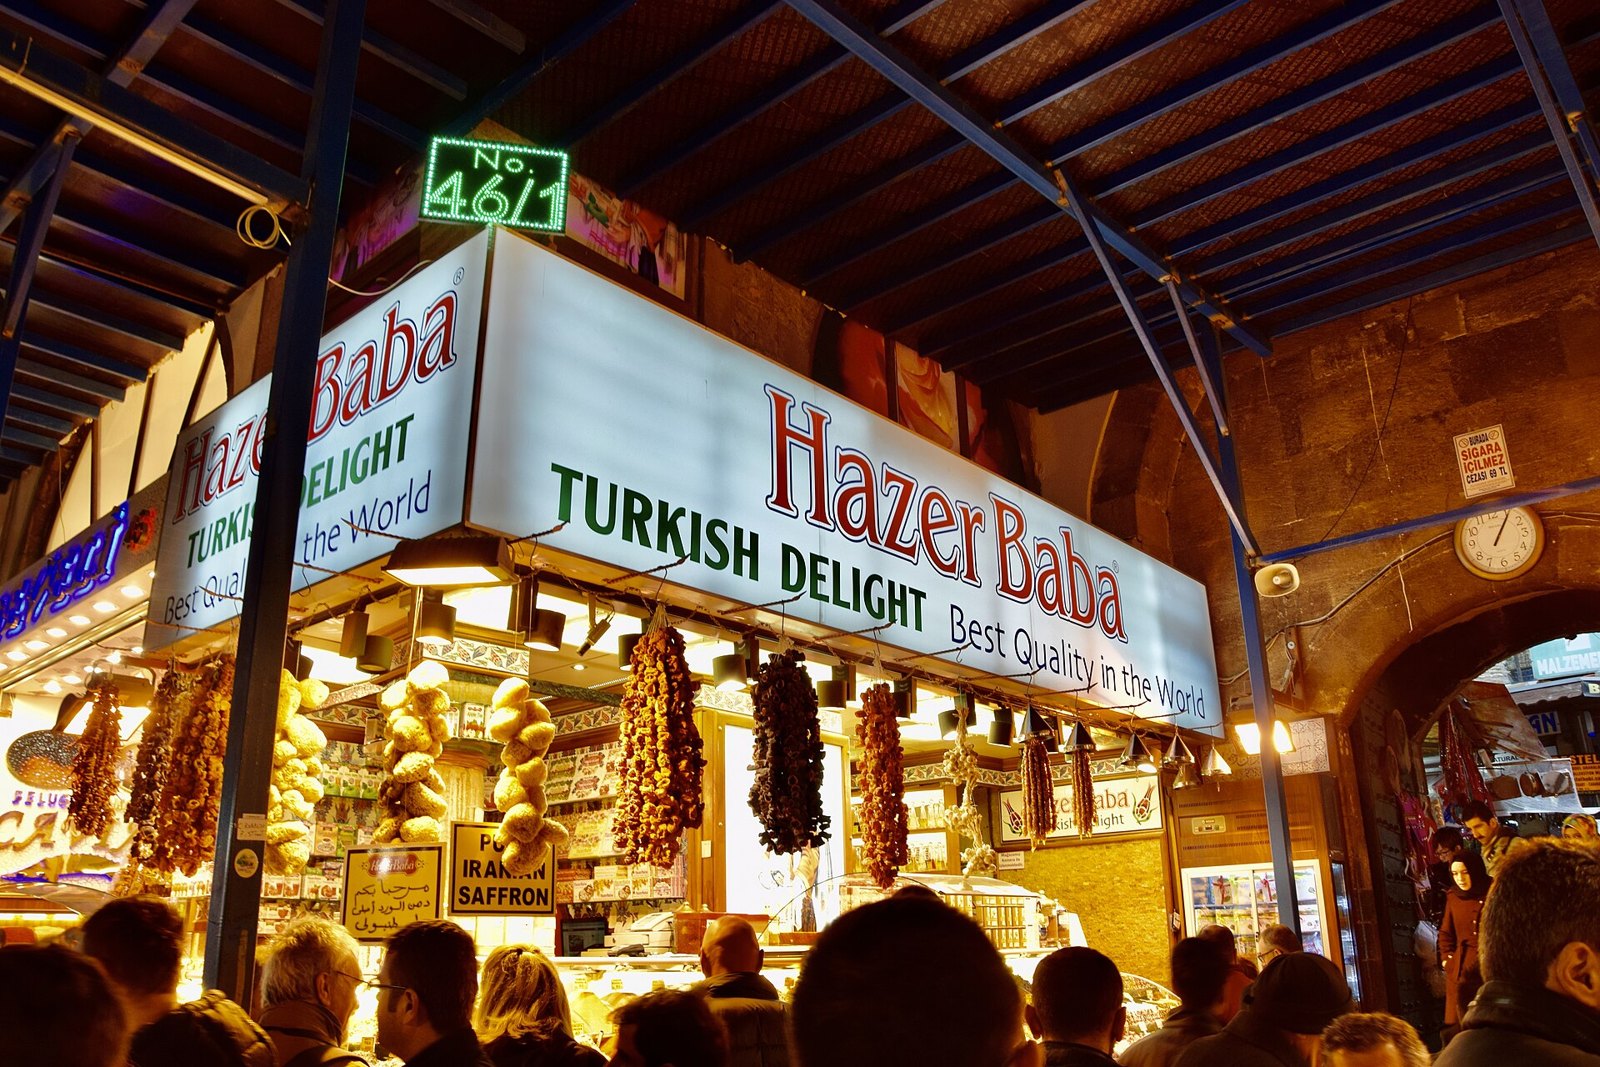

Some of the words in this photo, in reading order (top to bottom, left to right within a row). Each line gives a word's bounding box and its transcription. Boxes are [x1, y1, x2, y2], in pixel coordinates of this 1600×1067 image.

[429, 171, 560, 230] 46/1
[173, 408, 268, 525] Haze
[307, 290, 457, 447] Baba
[1469, 432, 1489, 446] BURADA
[1461, 442, 1502, 462] SİGARA
[1466, 471, 1488, 484] CEZASI
[1489, 468, 1498, 479] 69
[1499, 466, 1508, 476] TL
[187, 499, 255, 569] TURKI
[303, 520, 341, 564] the
[349, 470, 432, 545] World
[551, 462, 760, 582] TURKISH
[781, 542, 927, 632] DELIGHT
[764, 383, 986, 588] Hazer
[989, 492, 1128, 644] Baba
[165, 588, 199, 625] Best
[203, 558, 246, 610] Qual
[950, 603, 1006, 659] Best
[1014, 627, 1094, 693] Quality
[1101, 655, 1118, 684] in
[1122, 663, 1152, 702] the
[1155, 675, 1206, 720] World
[1092, 789, 1128, 809] aba
[458, 885, 548, 907] SAFFRON
